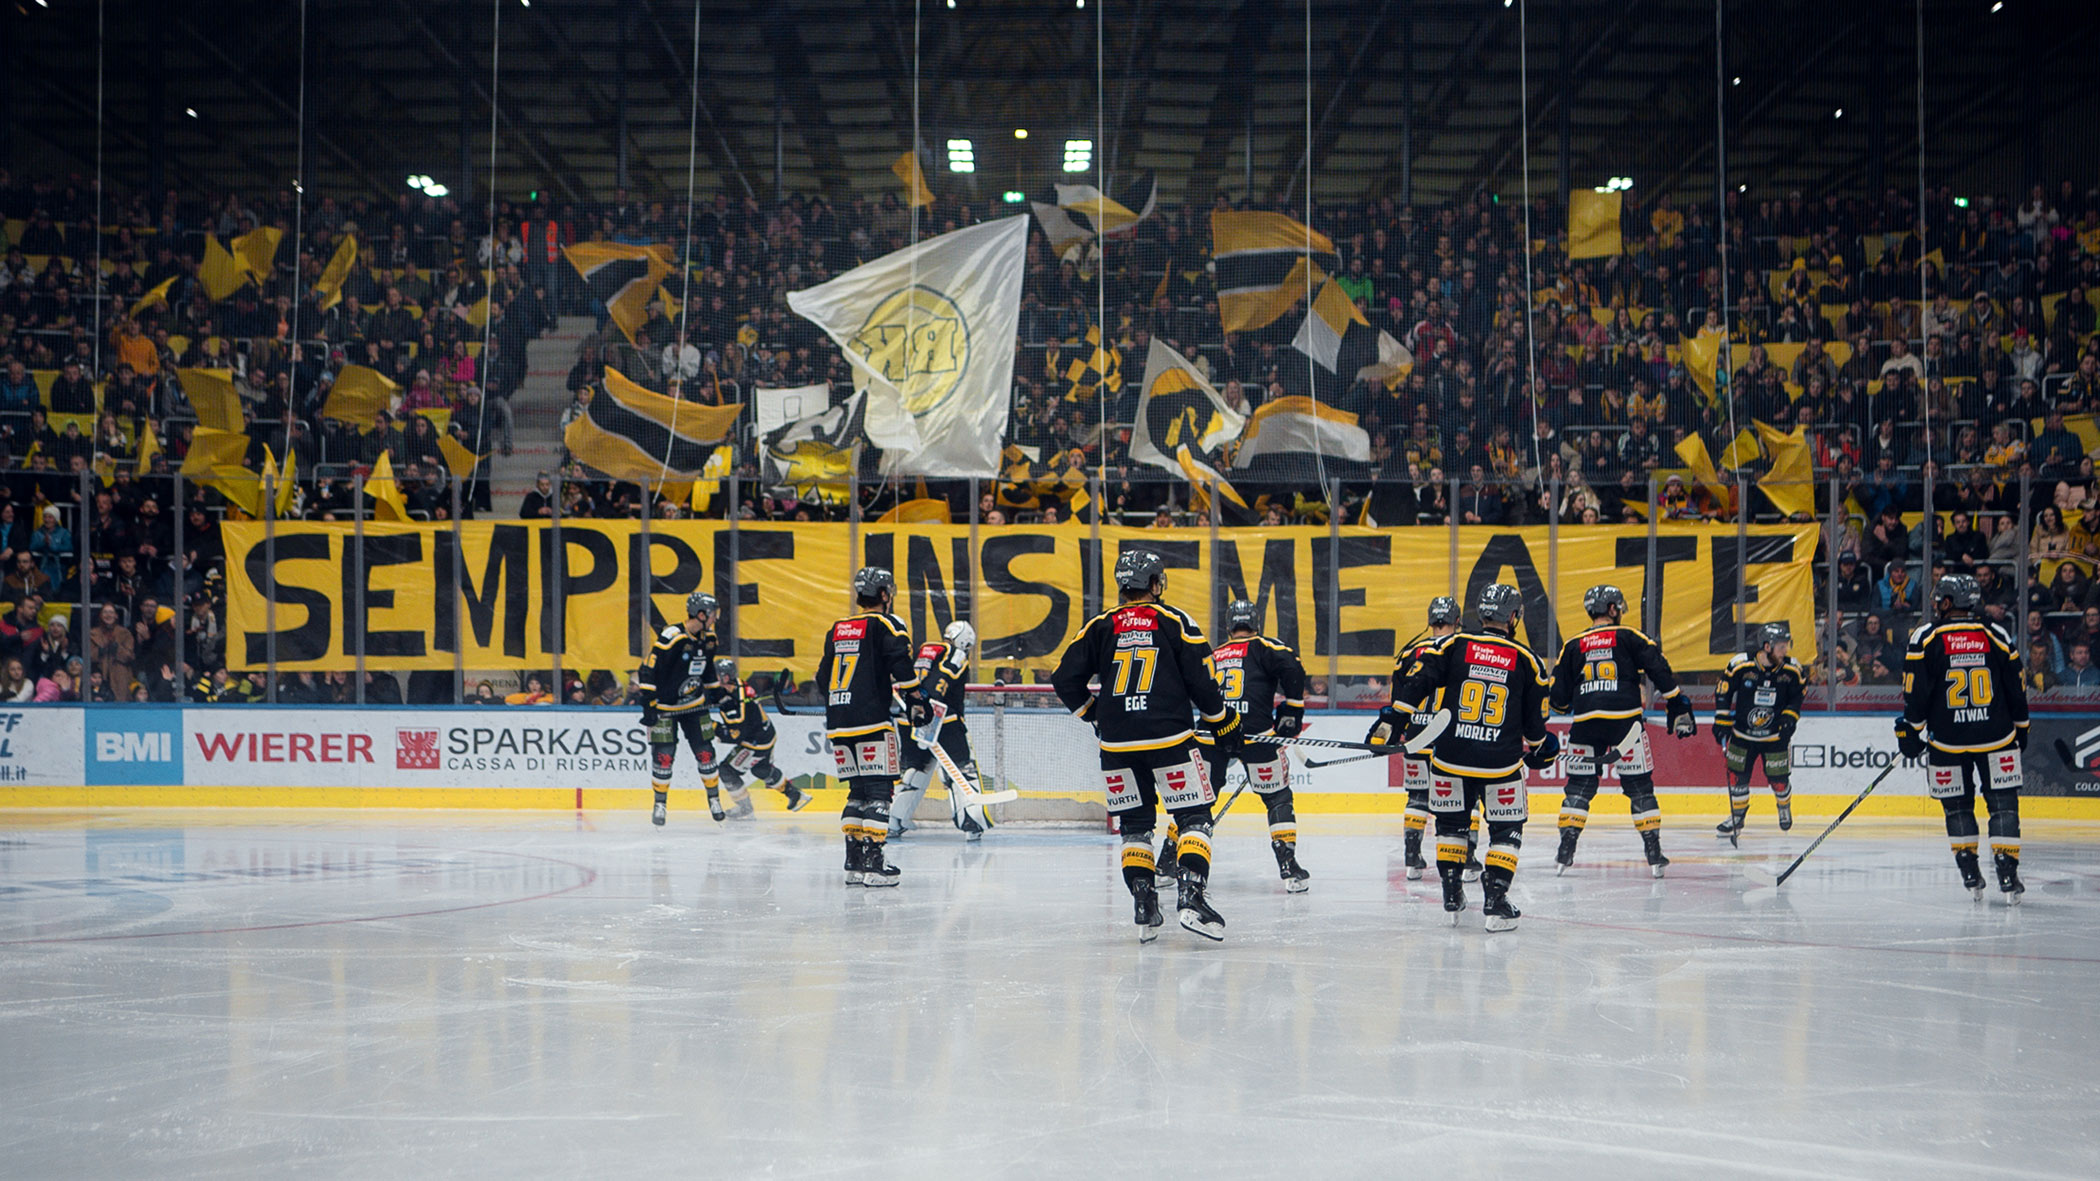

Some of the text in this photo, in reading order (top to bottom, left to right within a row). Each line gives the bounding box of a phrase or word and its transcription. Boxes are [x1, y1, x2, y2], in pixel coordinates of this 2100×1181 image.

[244, 524, 794, 666] SEMPRE
[1462, 535, 1562, 659] A
[1615, 535, 1794, 655] TE
[829, 653, 860, 692] 17
[1113, 647, 1159, 696] 77
[1474, 652, 1511, 667] Fairplay
[1580, 679, 1618, 695] STANTON
[1945, 667, 1994, 709] 20
[1125, 695, 1147, 711] EGE
[1458, 679, 1509, 727] 93
[1953, 708, 1989, 723] ATWAL
[447, 728, 647, 756] SPARKASS
[1455, 723, 1501, 742] MORLEY
[96, 732, 172, 762] BMI
[194, 732, 375, 763] WIERER
[448, 758, 648, 771] CASSA DI RISPARM
[2075, 782, 2100, 791] COLO
